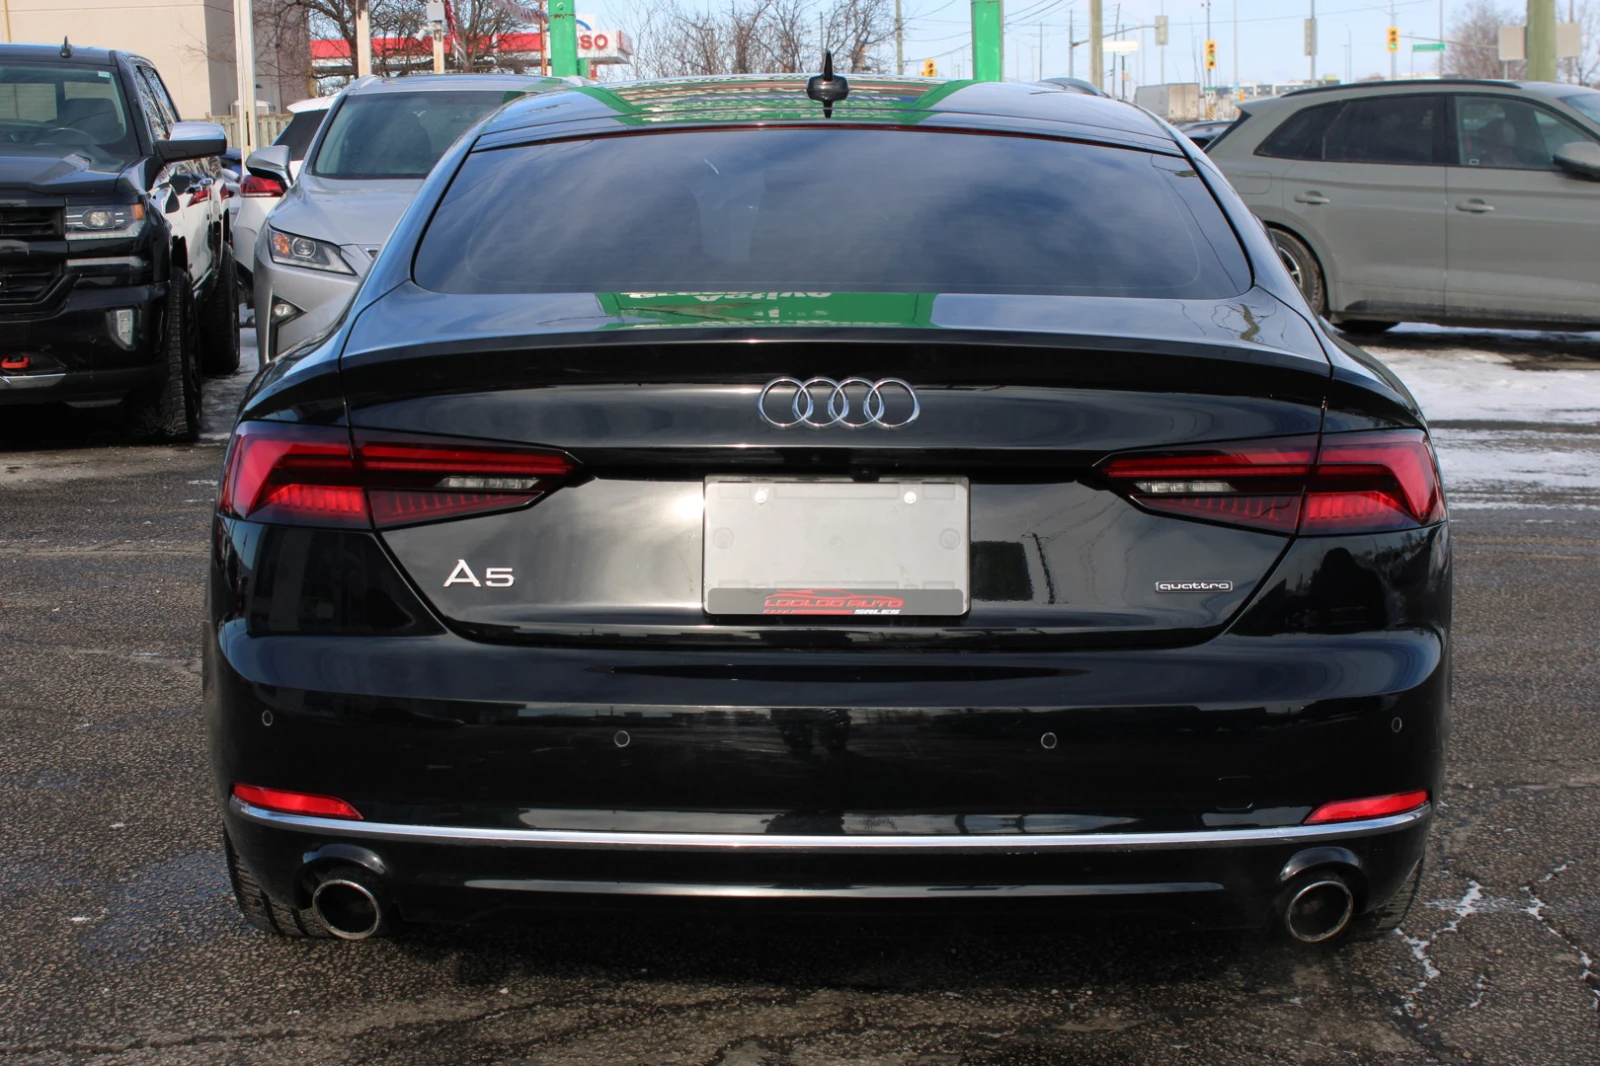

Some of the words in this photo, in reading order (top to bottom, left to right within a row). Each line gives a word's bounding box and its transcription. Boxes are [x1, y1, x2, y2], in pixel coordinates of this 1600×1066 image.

[443, 559, 516, 587] A5
[1158, 582, 1230, 591] quattro
[847, 599, 904, 608] AUTO
